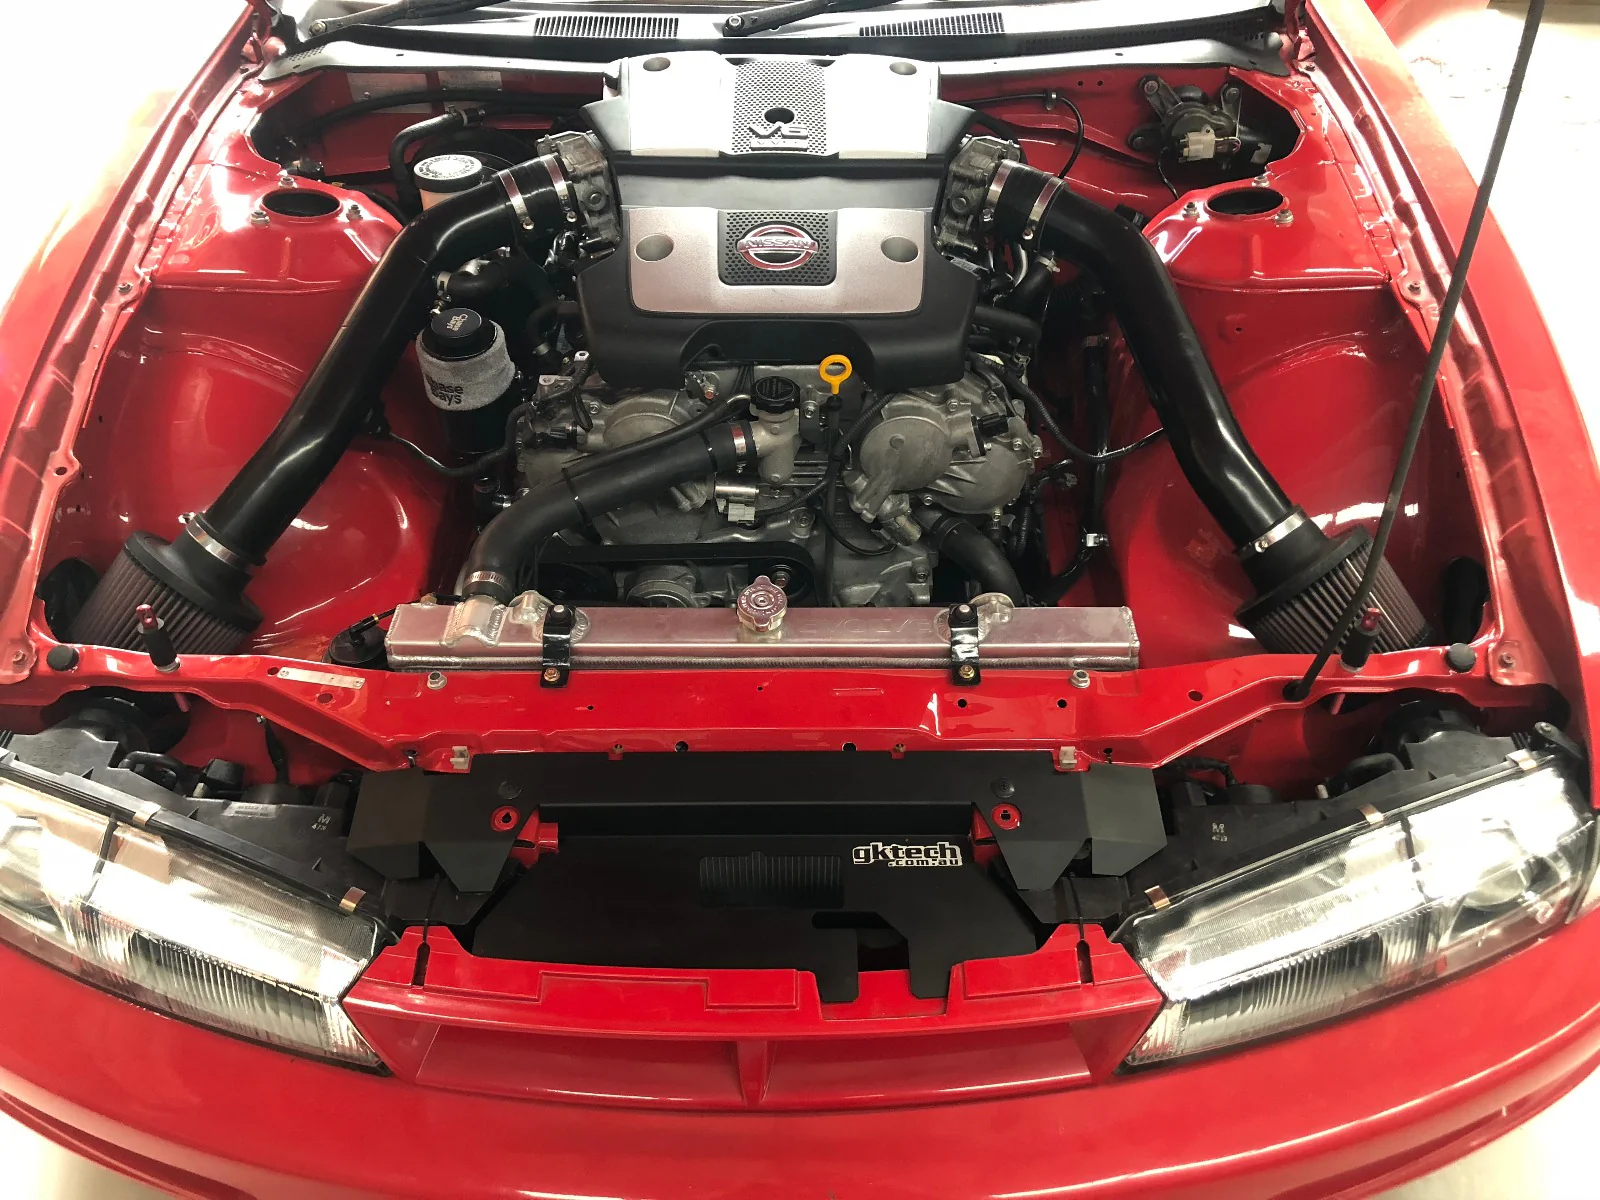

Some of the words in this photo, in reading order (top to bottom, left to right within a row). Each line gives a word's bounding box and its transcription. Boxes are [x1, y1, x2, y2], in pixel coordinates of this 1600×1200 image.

[748, 121, 808, 139] V6
[744, 239, 810, 249] NISSAN
[852, 841, 962, 864] gktech
